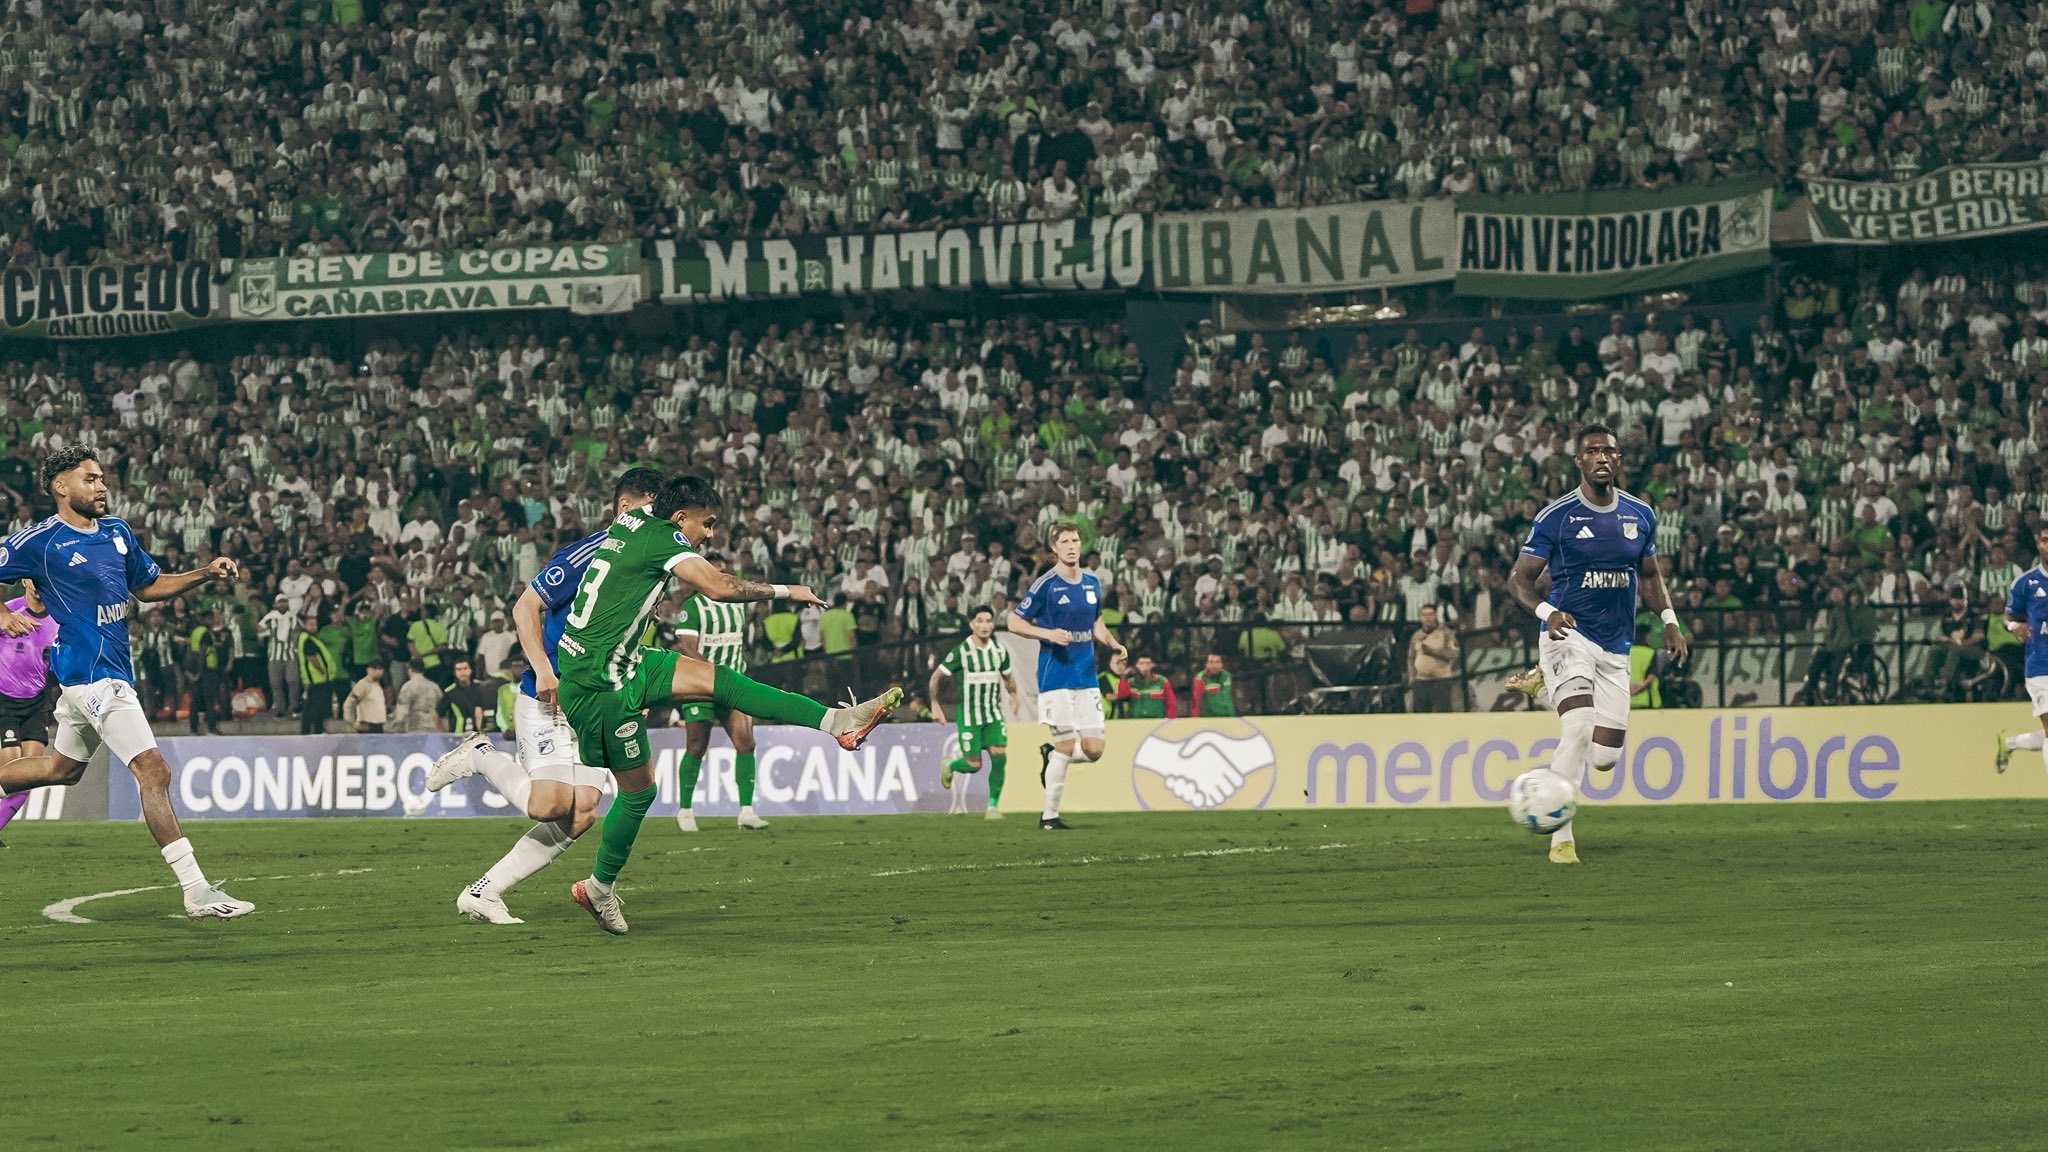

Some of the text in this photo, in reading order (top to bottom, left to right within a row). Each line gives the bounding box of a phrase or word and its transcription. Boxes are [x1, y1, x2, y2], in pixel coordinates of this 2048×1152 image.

[1808, 176, 1938, 213] PUERTO
[286, 244, 609, 284] REY DE COPAS
[1460, 204, 1721, 274] ADN VERDOLAGA
[3, 258, 211, 328] CAICEDO
[285, 283, 497, 318] CAÑABRAVA
[507, 283, 552, 307] LA
[179, 753, 468, 812] CONMEBOL
[1708, 715, 1900, 801] libre
